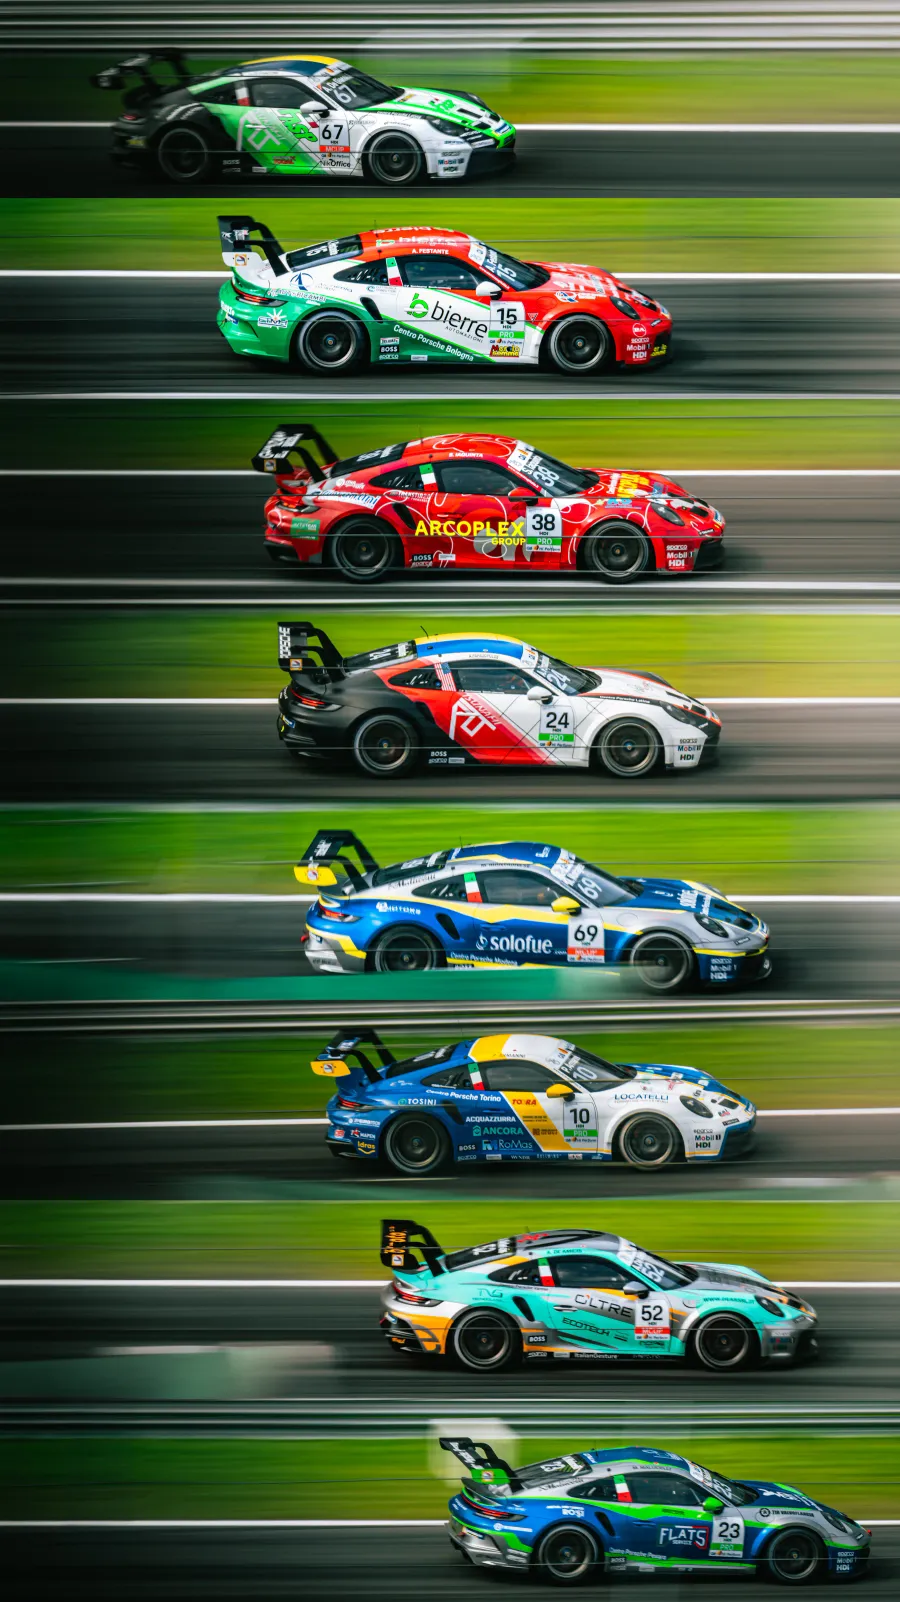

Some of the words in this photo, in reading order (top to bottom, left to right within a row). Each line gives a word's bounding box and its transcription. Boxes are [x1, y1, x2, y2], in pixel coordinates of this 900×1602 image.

[333, 84, 357, 103] 67
[321, 124, 344, 140] 67
[430, 301, 488, 339] bierre
[497, 308, 517, 325] 15
[393, 325, 417, 339] Centro
[417, 334, 445, 351] Porsche
[445, 345, 475, 362] Bologna
[632, 351, 647, 359] HDI
[414, 520, 525, 537] ARCOPLEX
[532, 513, 556, 531] 38
[491, 537, 526, 546] GROUP
[537, 537, 553, 545] PRO
[545, 711, 570, 729] 24
[578, 877, 603, 900] 69
[574, 924, 598, 942] 69
[490, 934, 553, 954] solofue
[407, 1098, 437, 1106] TOSINI
[449, 1092, 478, 1101] Porsche
[479, 1093, 502, 1102] Torino
[614, 1093, 668, 1101] LOCATELLI
[569, 1107, 590, 1124] 10
[483, 1126, 524, 1136] ANCORA
[499, 1139, 533, 1149] RoMas
[641, 1305, 664, 1321] 52
[659, 1528, 707, 1547] FLATS
[718, 1522, 740, 1538] 23
